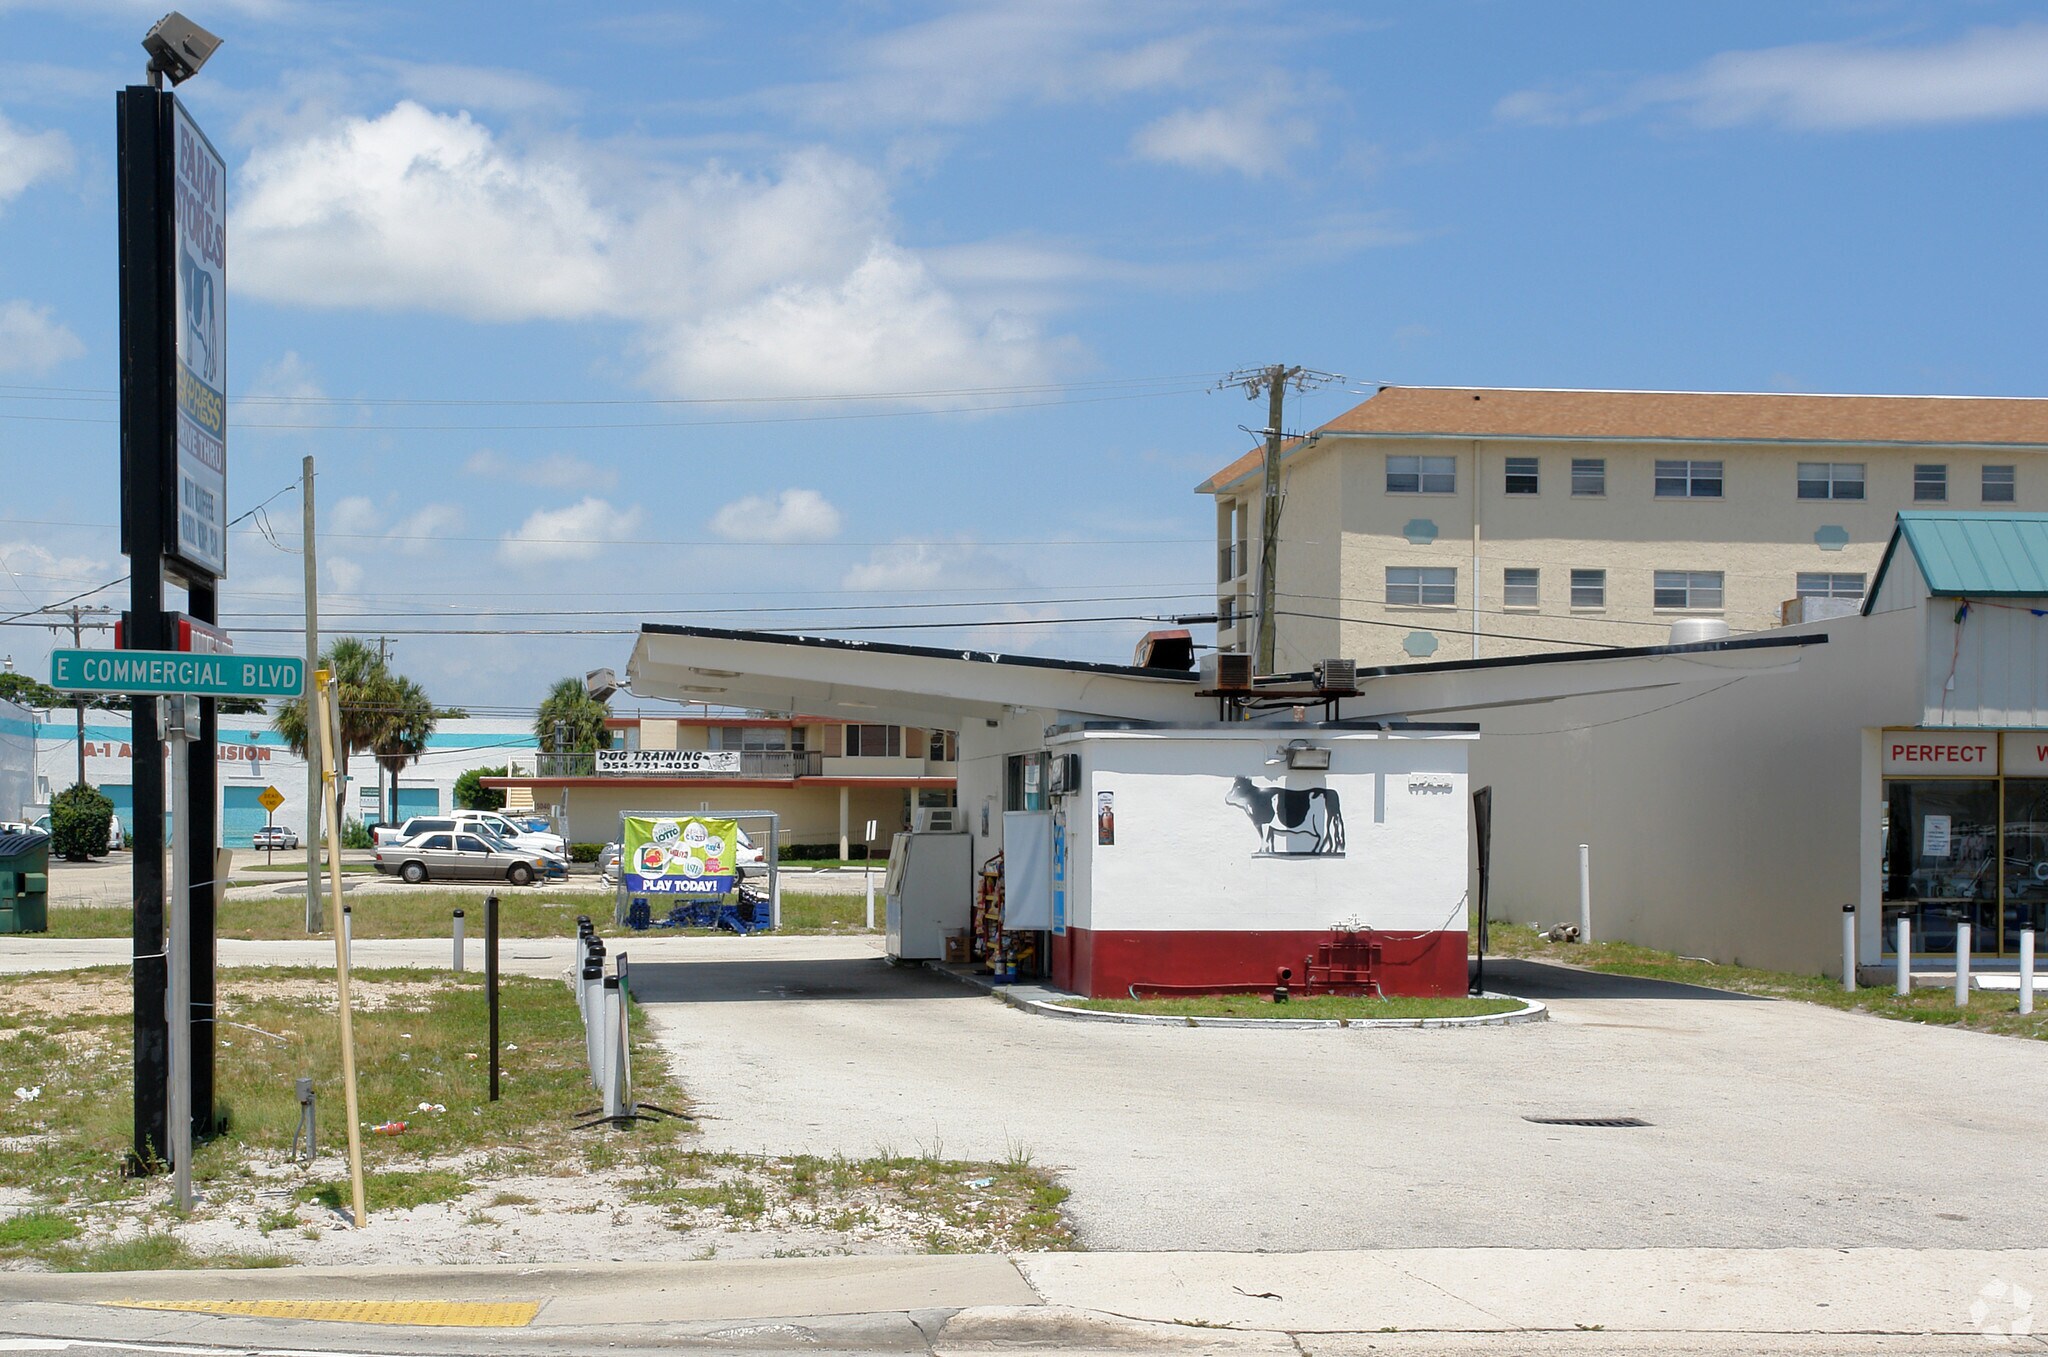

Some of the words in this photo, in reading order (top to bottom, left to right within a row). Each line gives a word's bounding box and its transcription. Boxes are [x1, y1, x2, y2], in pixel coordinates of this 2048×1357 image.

[180, 123, 217, 212] FARM
[176, 174, 224, 269] STORES
[177, 363, 221, 432] EXPRESS
[199, 433, 222, 470] THRU
[57, 658, 69, 681] E
[83, 659, 227, 686] COMMERCIAL
[242, 664, 296, 688] BLVD
[84, 742, 110, 757] A-1
[599, 751, 628, 761] DOG
[633, 751, 703, 761] TRAINING
[1892, 745, 1987, 762] PERFECT
[603, 762, 700, 770] 954-771-4030
[655, 828, 679, 842] LOTTO
[643, 880, 673, 891] PLAY
[674, 880, 718, 892] TODAY!
